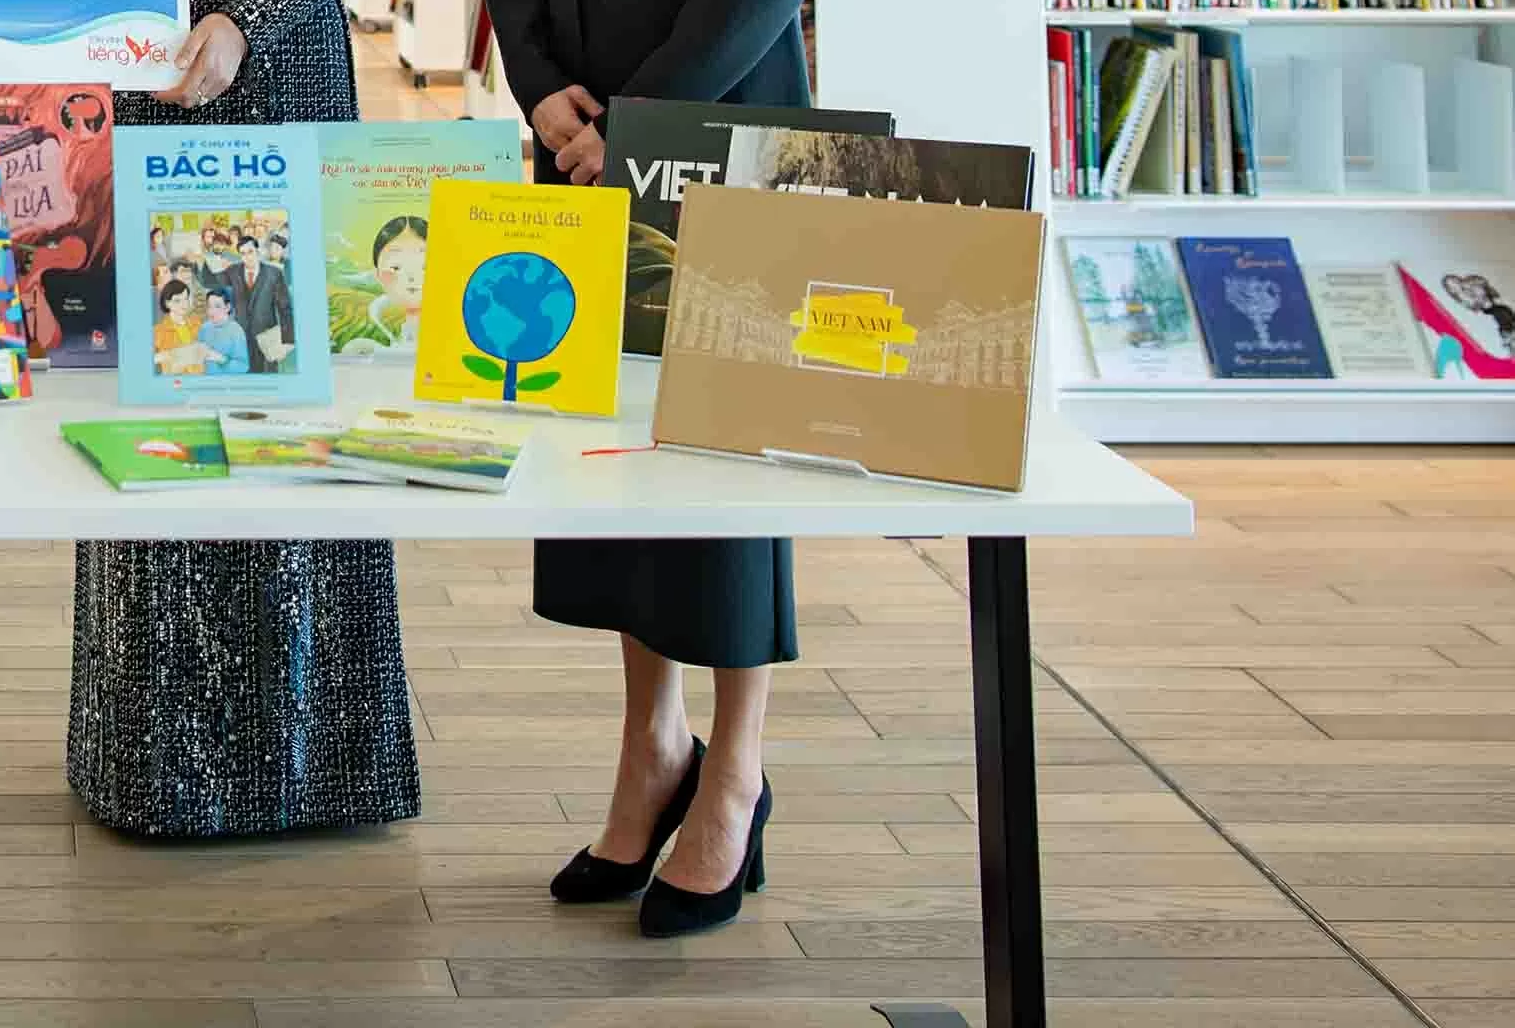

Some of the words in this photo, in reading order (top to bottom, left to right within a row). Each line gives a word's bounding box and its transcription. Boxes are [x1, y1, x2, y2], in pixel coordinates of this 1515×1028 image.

[146, 150, 219, 179] BÁC
[233, 143, 287, 178] HỒ
[855, 315, 892, 333] NAM
